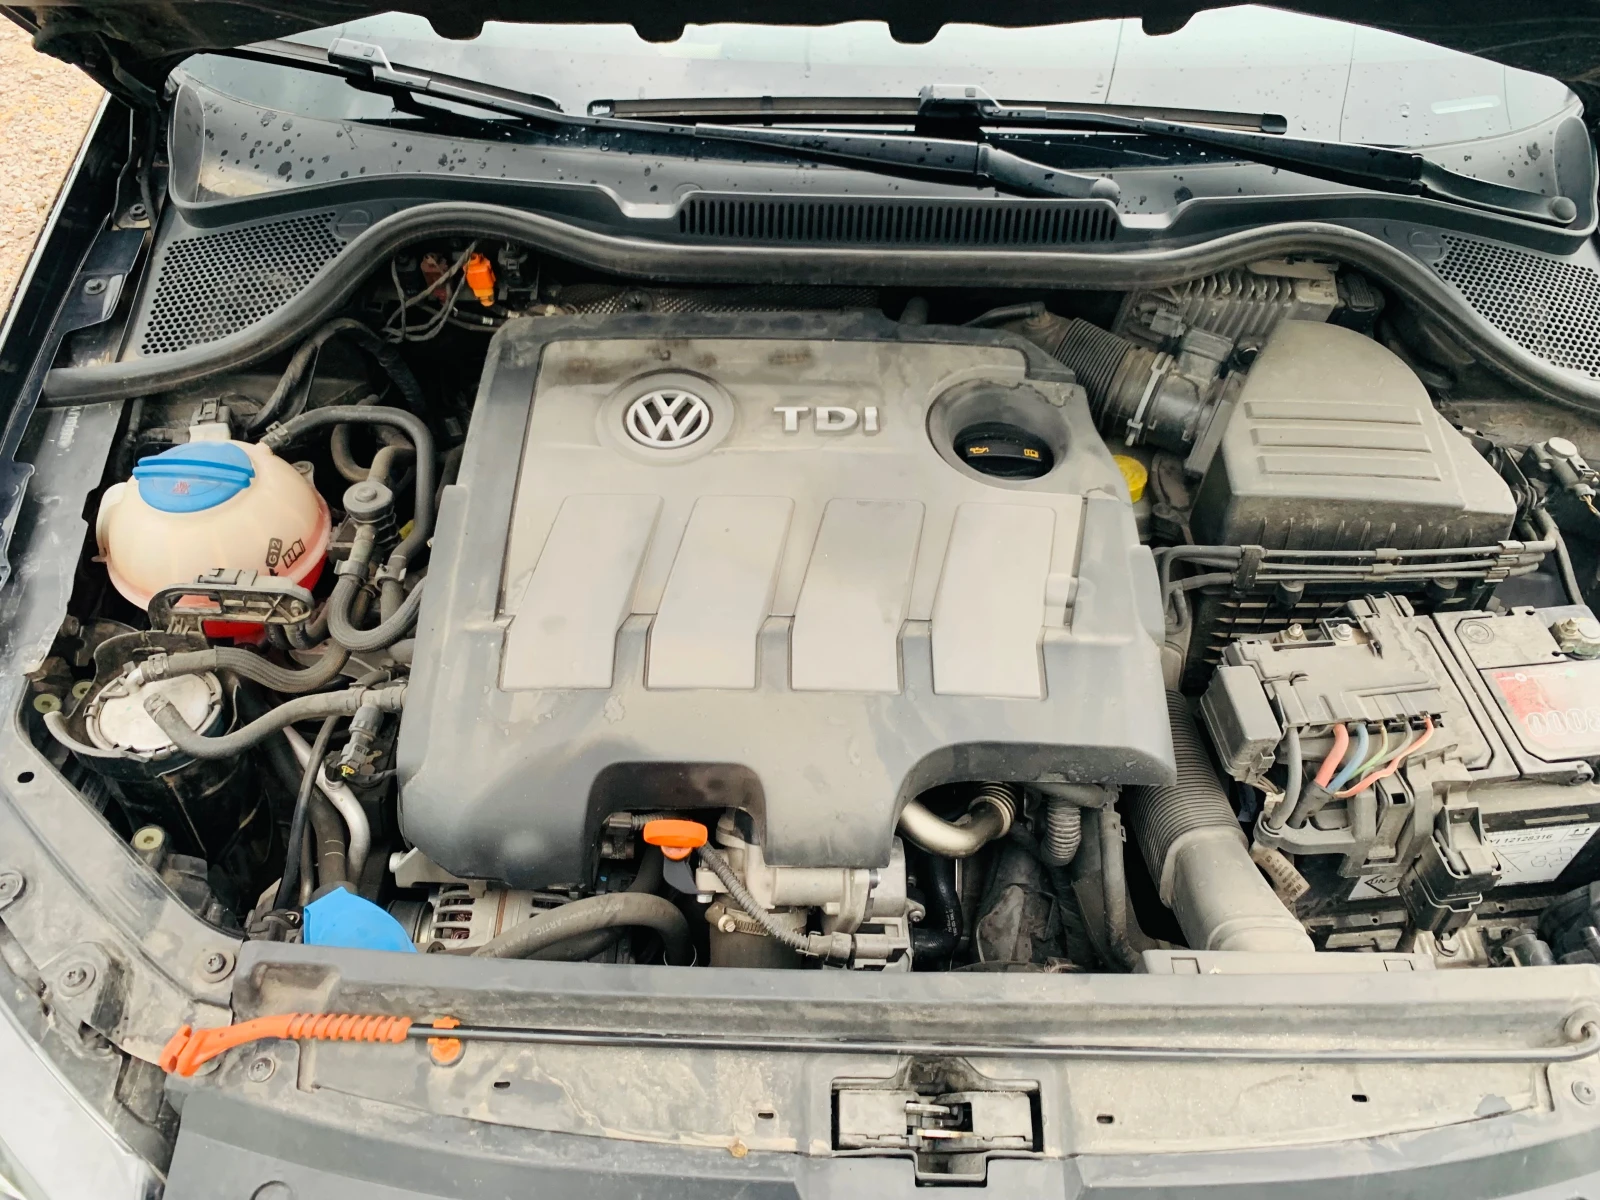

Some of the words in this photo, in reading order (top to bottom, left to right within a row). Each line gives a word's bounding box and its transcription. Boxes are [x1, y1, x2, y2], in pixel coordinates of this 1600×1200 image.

[772, 404, 881, 435] TDI
[268, 539, 281, 565] G12
[534, 920, 562, 936] ARTIC
